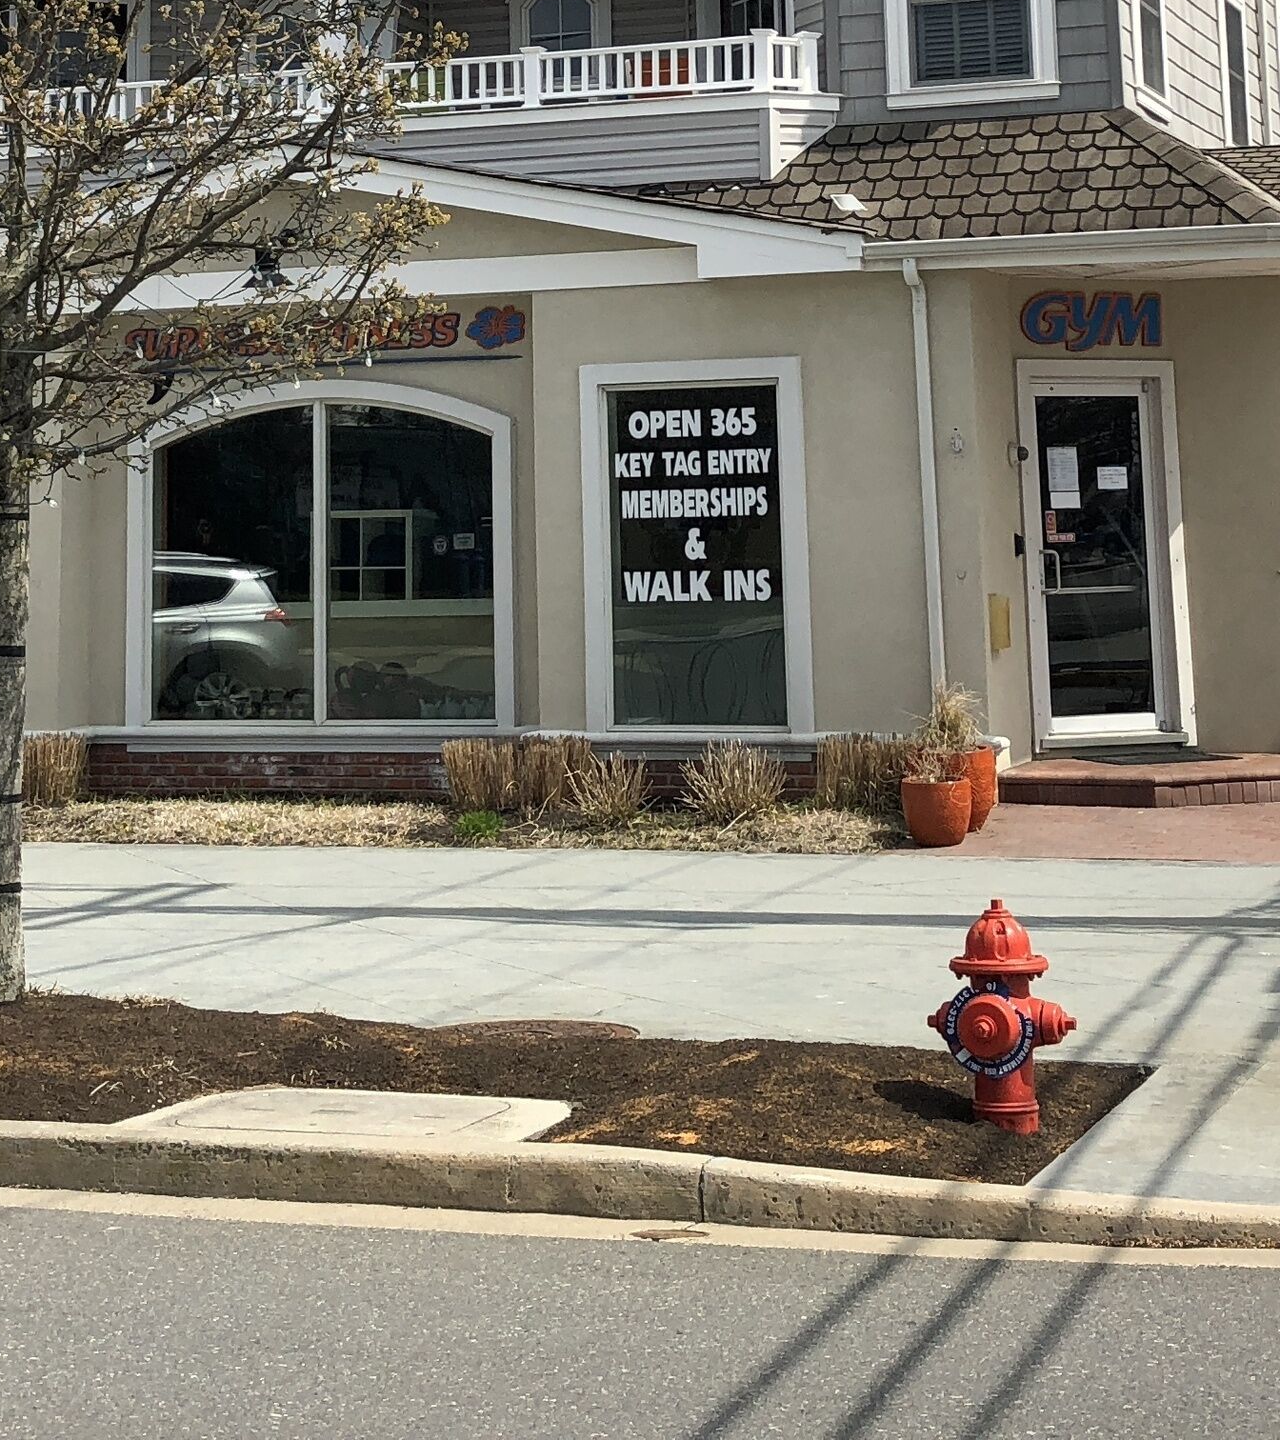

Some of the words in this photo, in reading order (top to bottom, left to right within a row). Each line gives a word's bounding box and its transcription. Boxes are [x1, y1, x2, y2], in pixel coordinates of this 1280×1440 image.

[1020, 290, 1162, 352] GYM
[628, 410, 702, 439] OPEN
[710, 407, 757, 436] 365
[615, 452, 654, 478] KEY
[662, 450, 701, 476] TAG
[708, 448, 772, 475] ENTRY
[621, 486, 768, 519] MEMBERSHIPS
[684, 527, 707, 560] &
[623, 570, 712, 602] WALK
[723, 569, 771, 601] INS
